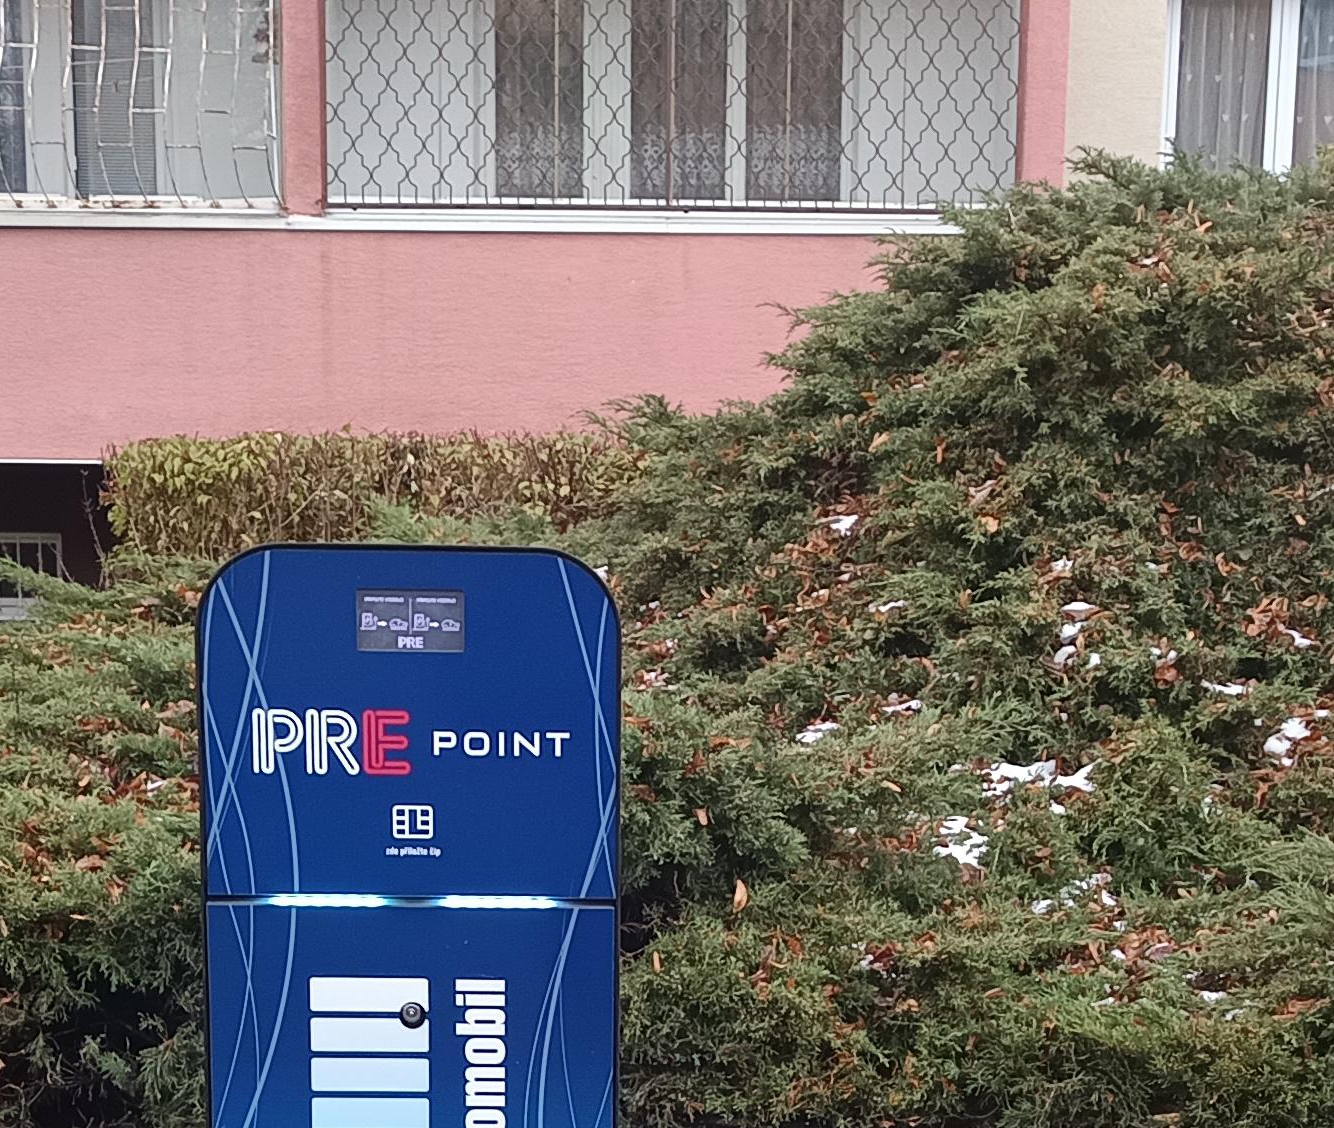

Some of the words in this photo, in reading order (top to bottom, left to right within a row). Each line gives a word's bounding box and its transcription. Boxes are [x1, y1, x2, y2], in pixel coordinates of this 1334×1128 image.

[397, 636, 424, 649] PRE
[252, 707, 411, 776] PRE
[432, 730, 571, 758] POINT
